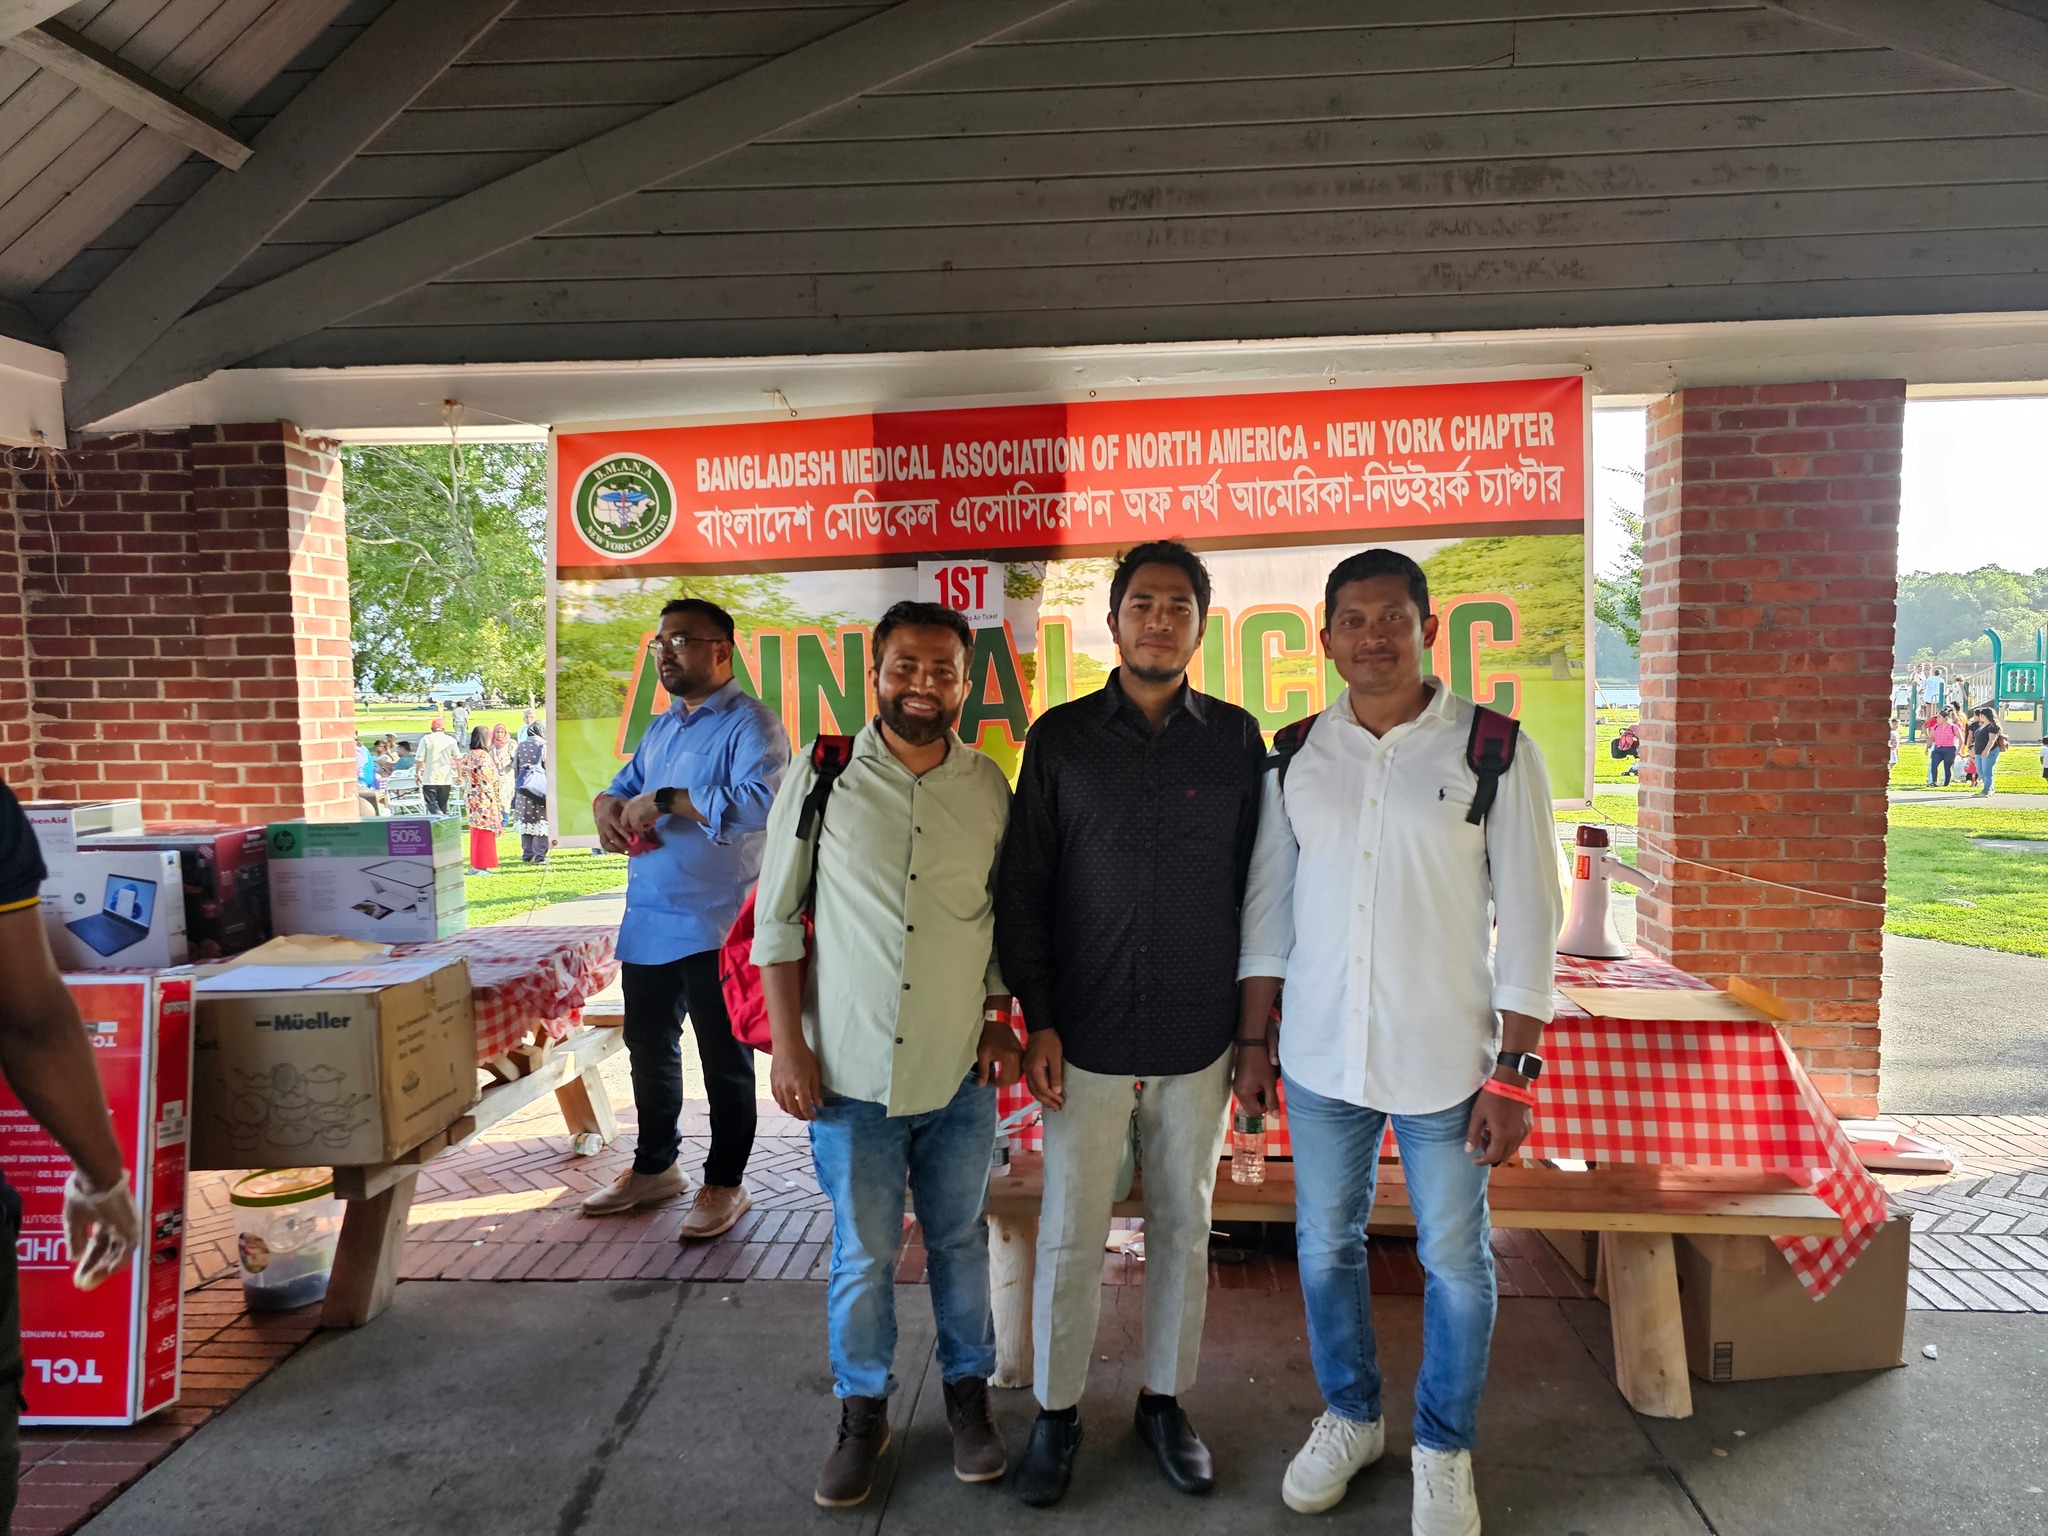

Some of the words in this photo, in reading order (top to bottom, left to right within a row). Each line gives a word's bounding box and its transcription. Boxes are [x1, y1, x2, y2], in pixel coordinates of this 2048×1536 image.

[696, 450, 836, 493] BANGLADESH
[841, 444, 936, 485] MEDICAL
[941, 436, 1086, 479] ASSOCIATION
[1092, 434, 1120, 471] OF
[1126, 429, 1202, 469] NORTH
[1208, 425, 1309, 465] AMERICA
[1326, 420, 1376, 458] NEW
[1381, 417, 1445, 455] YORK
[1450, 411, 1556, 452] CHAPTER
[593, 461, 653, 480] B.M.A.N.A
[693, 500, 815, 549] বাংলাদেশ
[824, 488, 941, 540] মেডিকেল
[950, 480, 1116, 534] এসোসিয়েশন
[1120, 486, 1174, 526] অফ
[1178, 467, 1224, 523] নর্থ
[1226, 455, 1473, 520] আমেরিকা-নিউইয়র্ক
[1475, 453, 1565, 507] চ্যাপ্টার
[585, 525, 605, 544] NEW
[604, 540, 633, 552] YORK
[632, 514, 669, 549] CHAPTER
[934, 565, 989, 612] 1ST
[982, 612, 998, 620] Ticket
[390, 829, 422, 843] 50%
[274, 1011, 352, 1032] Müeller
[89, 1034, 117, 1048] TC
[35, 1185, 66, 1194] AMING
[19, 1330, 56, 1338] PARTNER
[57, 1330, 68, 1338] TV
[69, 1330, 105, 1338] OFFICIAL
[32, 1358, 103, 1385] TCL
